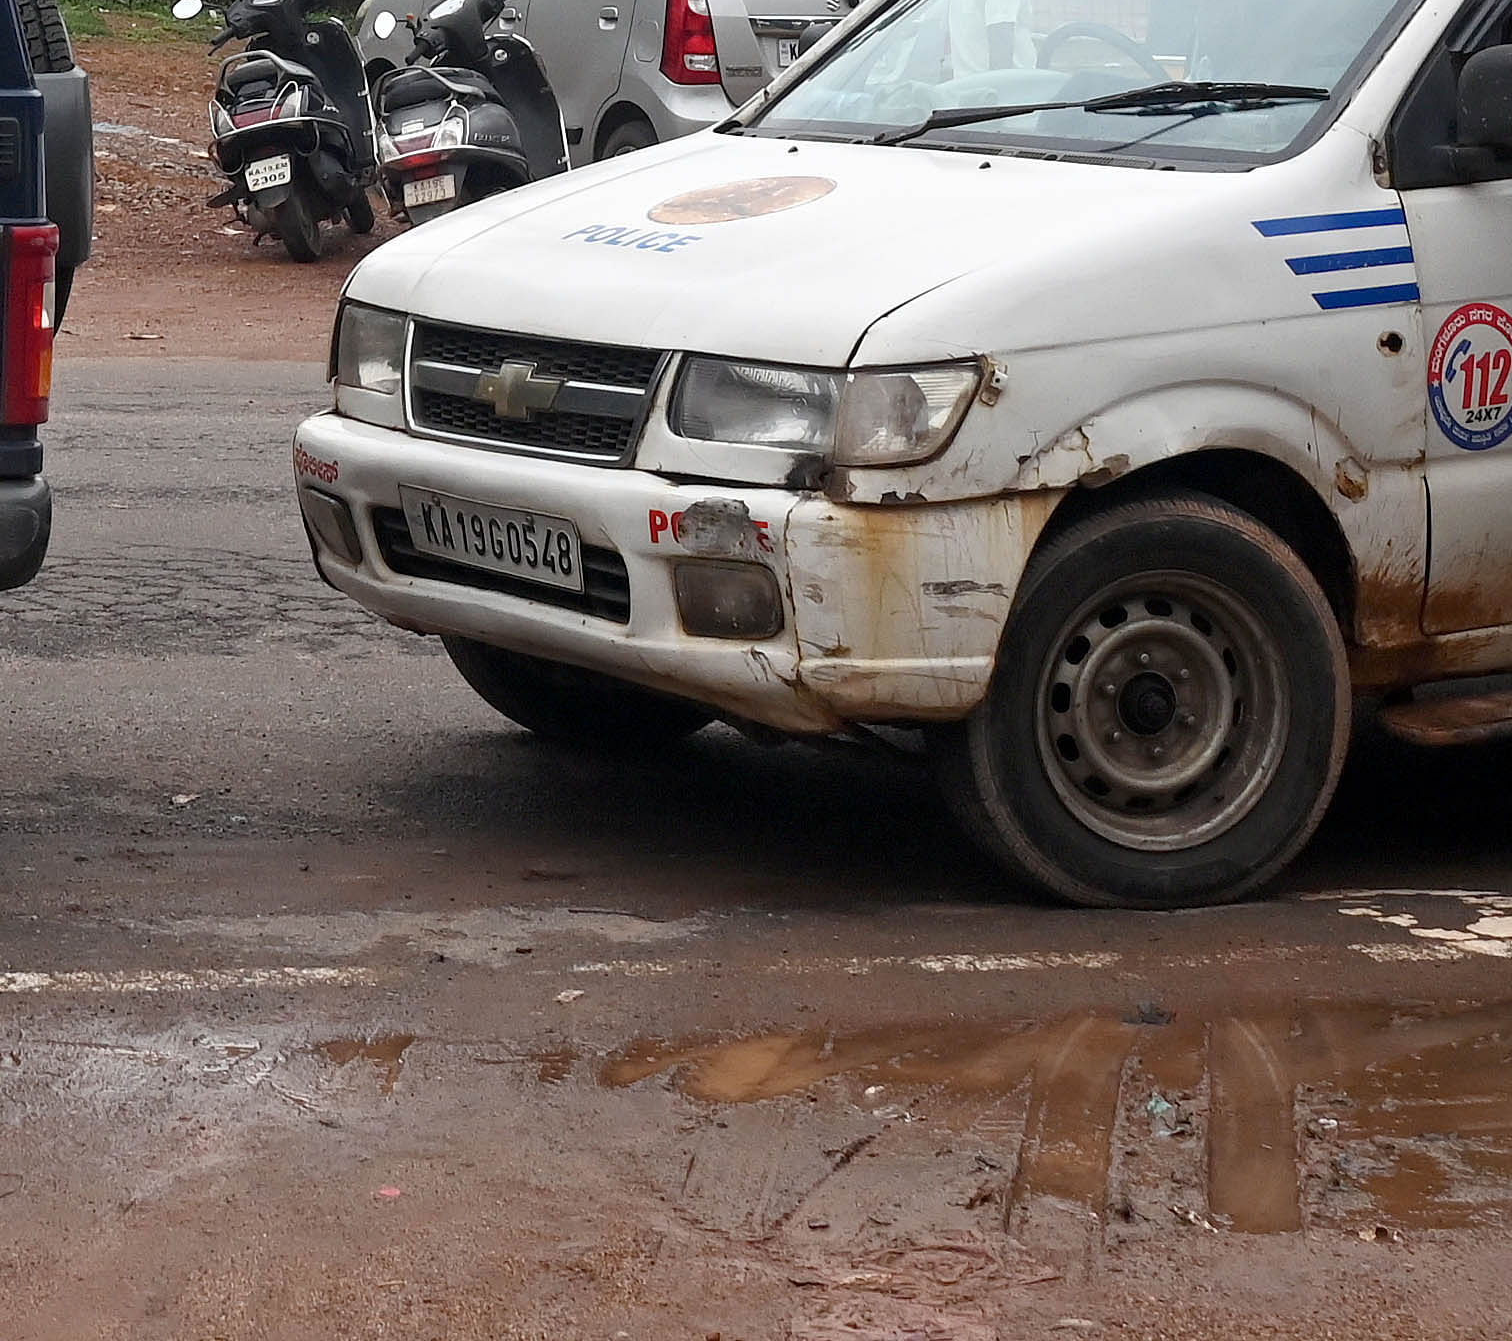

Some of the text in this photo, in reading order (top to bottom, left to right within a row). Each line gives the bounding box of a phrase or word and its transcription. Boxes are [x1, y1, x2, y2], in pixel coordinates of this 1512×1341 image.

[251, 171, 287, 188] 2305
[563, 223, 704, 255] POLICE
[1460, 348, 1512, 410] 112
[1464, 406, 1502, 424] 24X7
[422, 499, 573, 576] KA19G0548
